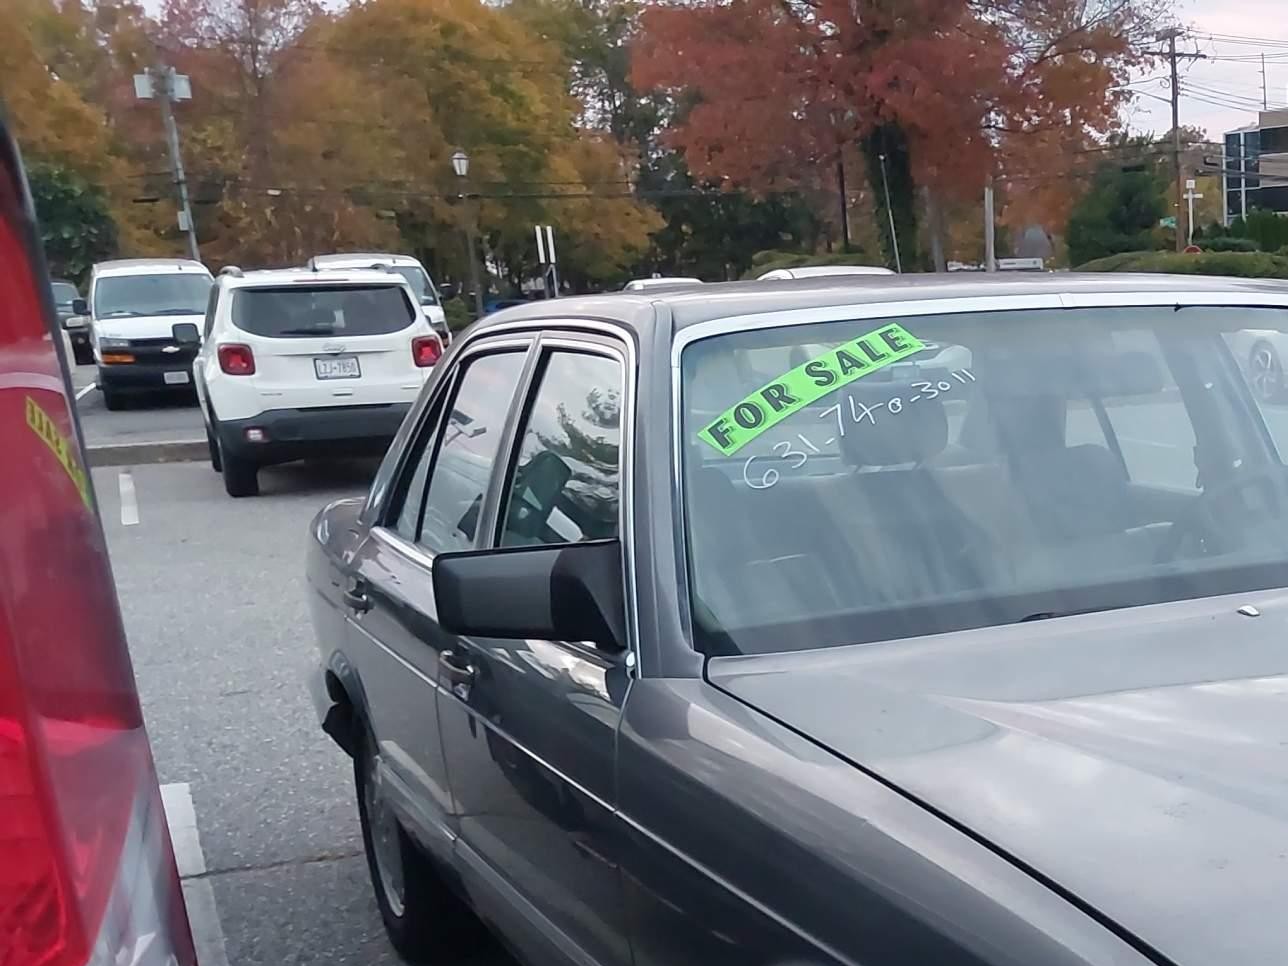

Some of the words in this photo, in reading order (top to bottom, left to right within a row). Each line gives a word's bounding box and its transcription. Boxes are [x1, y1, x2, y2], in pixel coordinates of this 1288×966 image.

[707, 381, 797, 450] FOR
[805, 327, 912, 389] SALE
[743, 368, 976, 490] 631-740-3011
